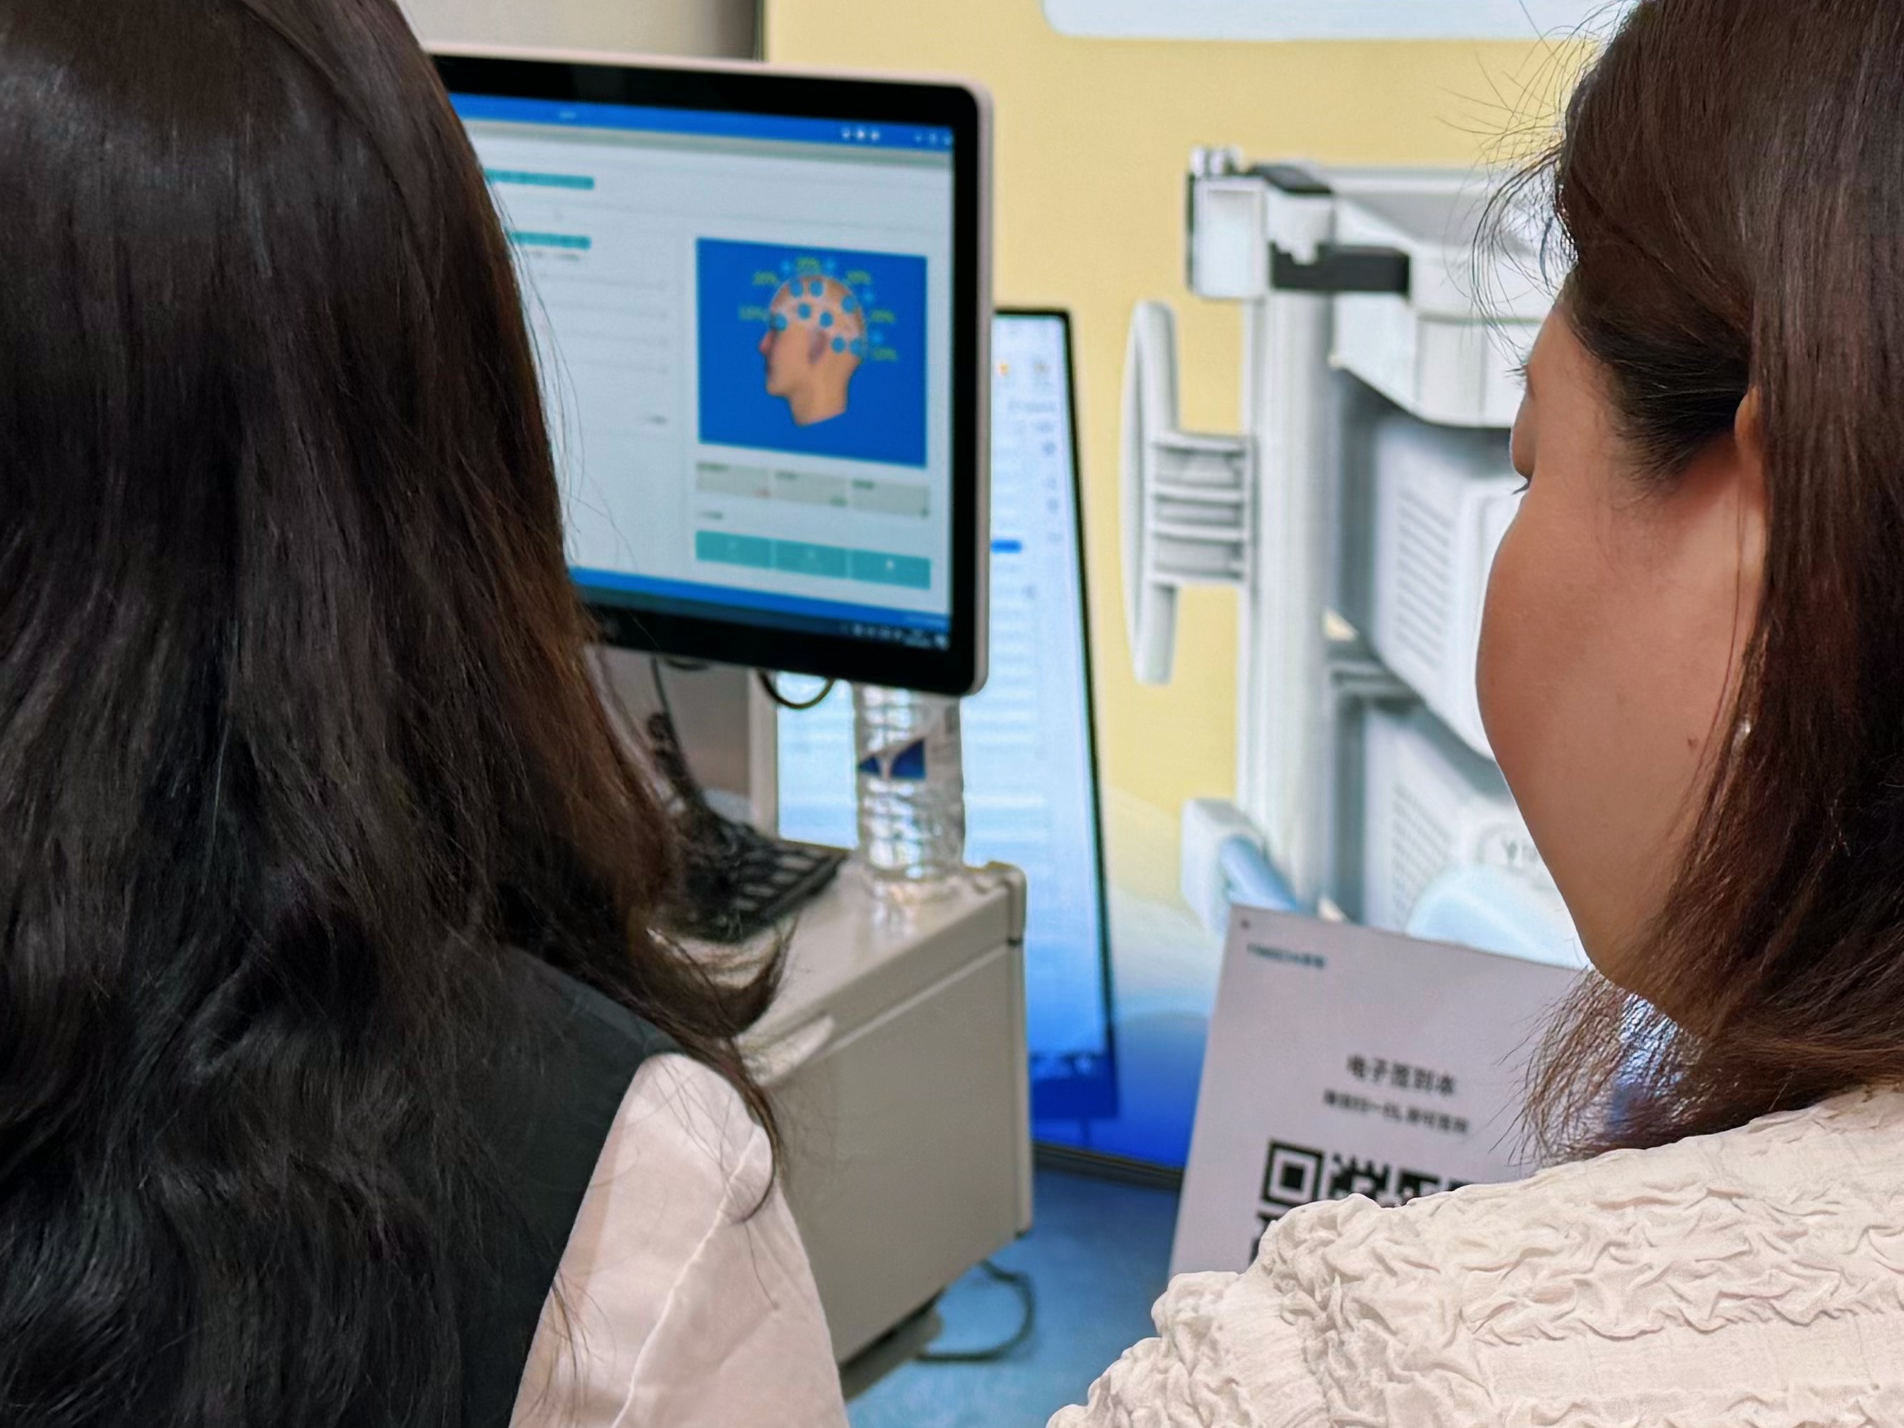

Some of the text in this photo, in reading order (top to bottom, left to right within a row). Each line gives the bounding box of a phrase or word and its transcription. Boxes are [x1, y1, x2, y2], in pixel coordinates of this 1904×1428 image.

[1346, 1054, 1456, 1097] 电子签到本
